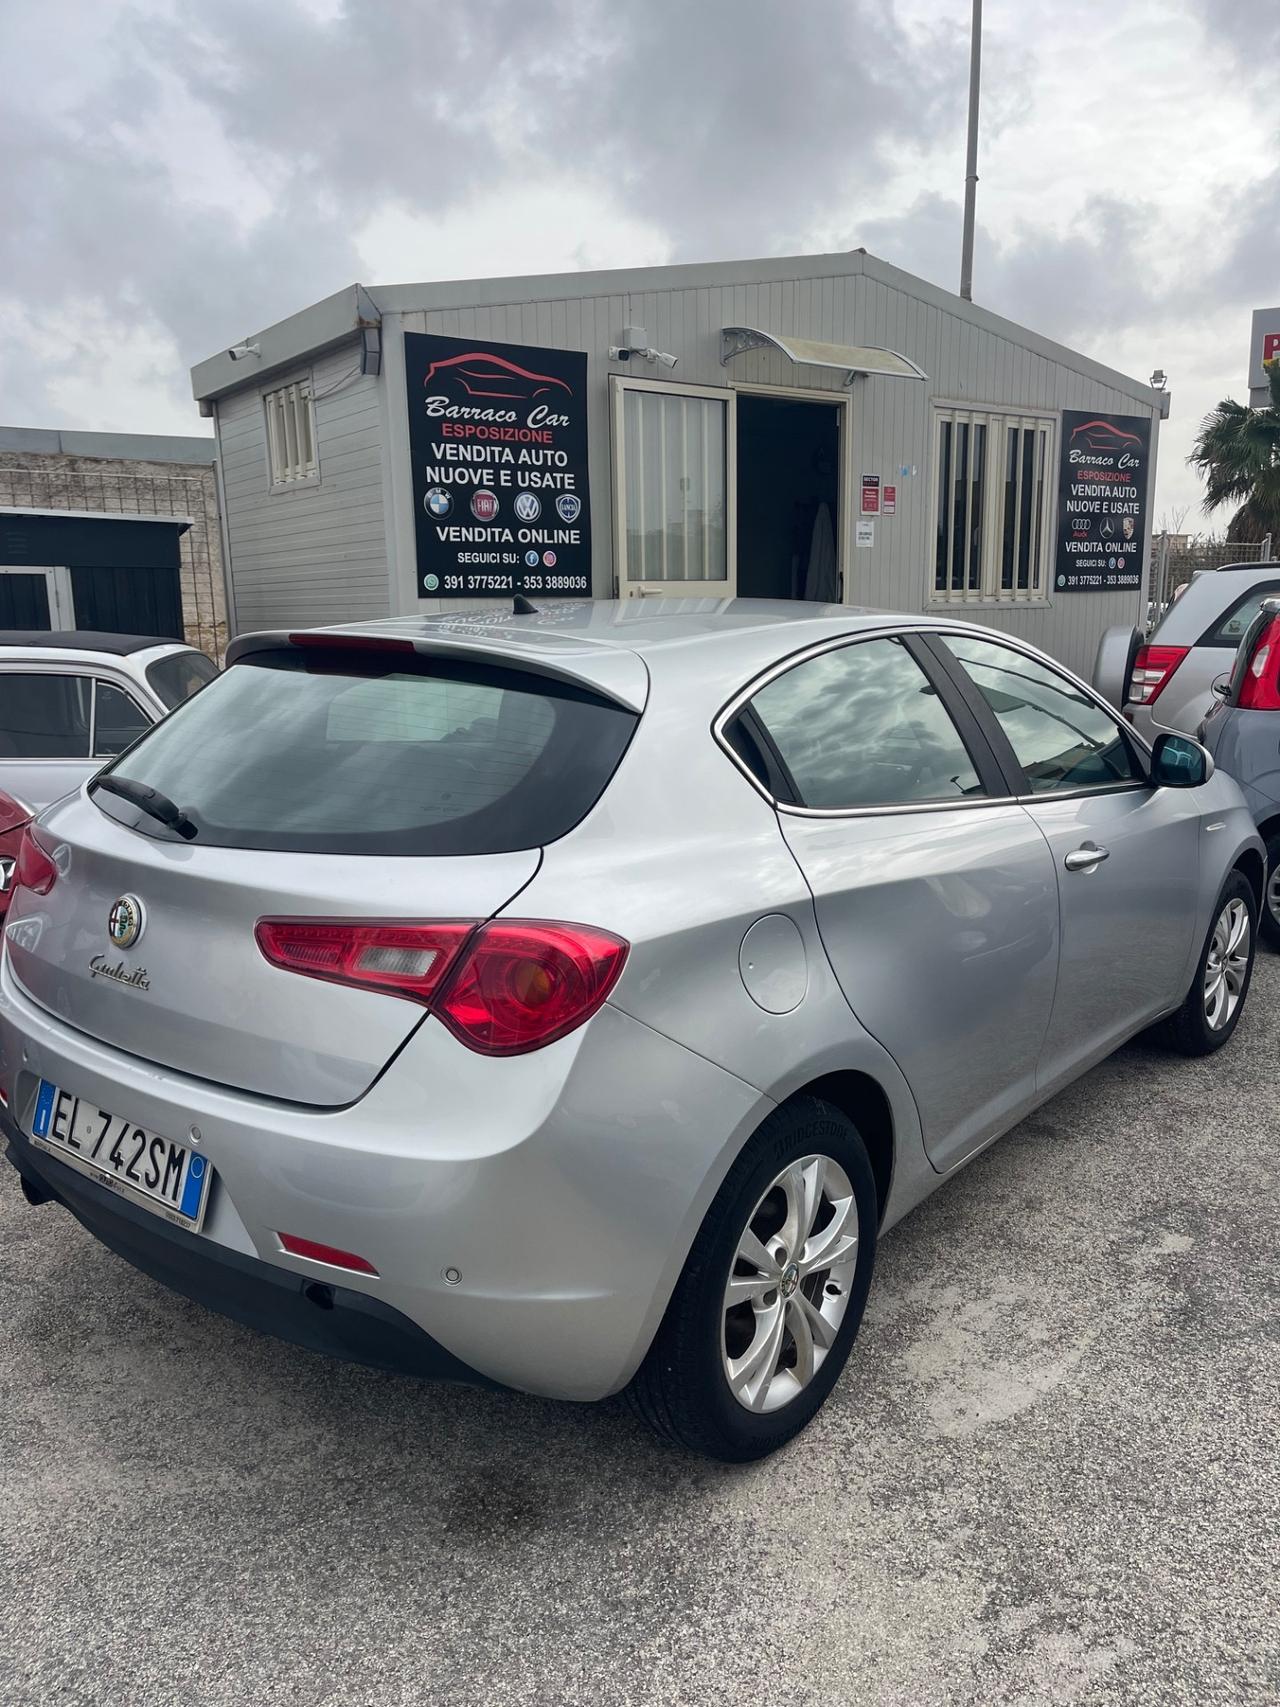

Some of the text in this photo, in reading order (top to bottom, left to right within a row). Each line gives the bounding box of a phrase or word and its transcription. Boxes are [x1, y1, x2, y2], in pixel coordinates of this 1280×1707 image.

[425, 396, 570, 428] Barraco Car
[442, 423, 553, 443] ESPOSIZIONE
[431, 442, 567, 467] VENDITA AUTO
[1069, 450, 1140, 469] Barraco Car
[426, 466, 575, 489] NUOVE E USATE
[1077, 471, 1131, 482] ESPOSIZIONE
[1071, 484, 1137, 498] VENDITA AUTO
[1066, 500, 1140, 514] NUOVE E USATE
[436, 526, 580, 544] VENDITA ONLINE
[1066, 542, 1137, 552] VENDITA ONLINE
[458, 552, 520, 563] SEGUICI SU:
[444, 575, 464, 589] 391
[468, 575, 513, 589] 3775221
[524, 576, 542, 589] 353
[545, 576, 587, 589] 3889036
[1068, 576, 1078, 585] 391
[1080, 576, 1102, 585] 3775221
[52, 1090, 186, 1202] EL 742SM
